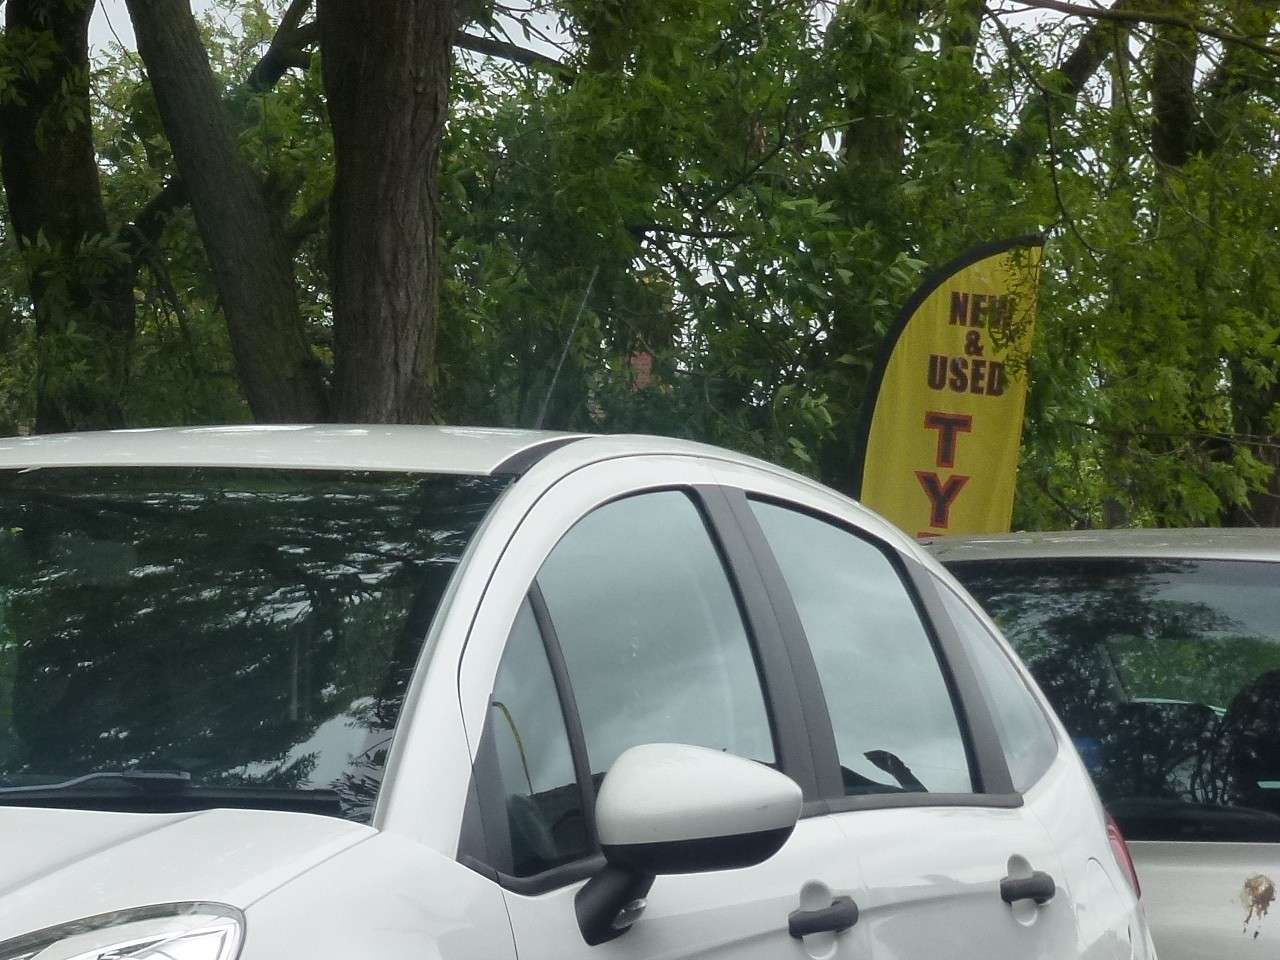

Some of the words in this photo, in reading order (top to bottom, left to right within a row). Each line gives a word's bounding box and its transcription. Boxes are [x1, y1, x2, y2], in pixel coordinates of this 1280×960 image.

[948, 291, 1014, 329] NEW
[964, 329, 984, 357] &
[927, 354, 1007, 396] USED
